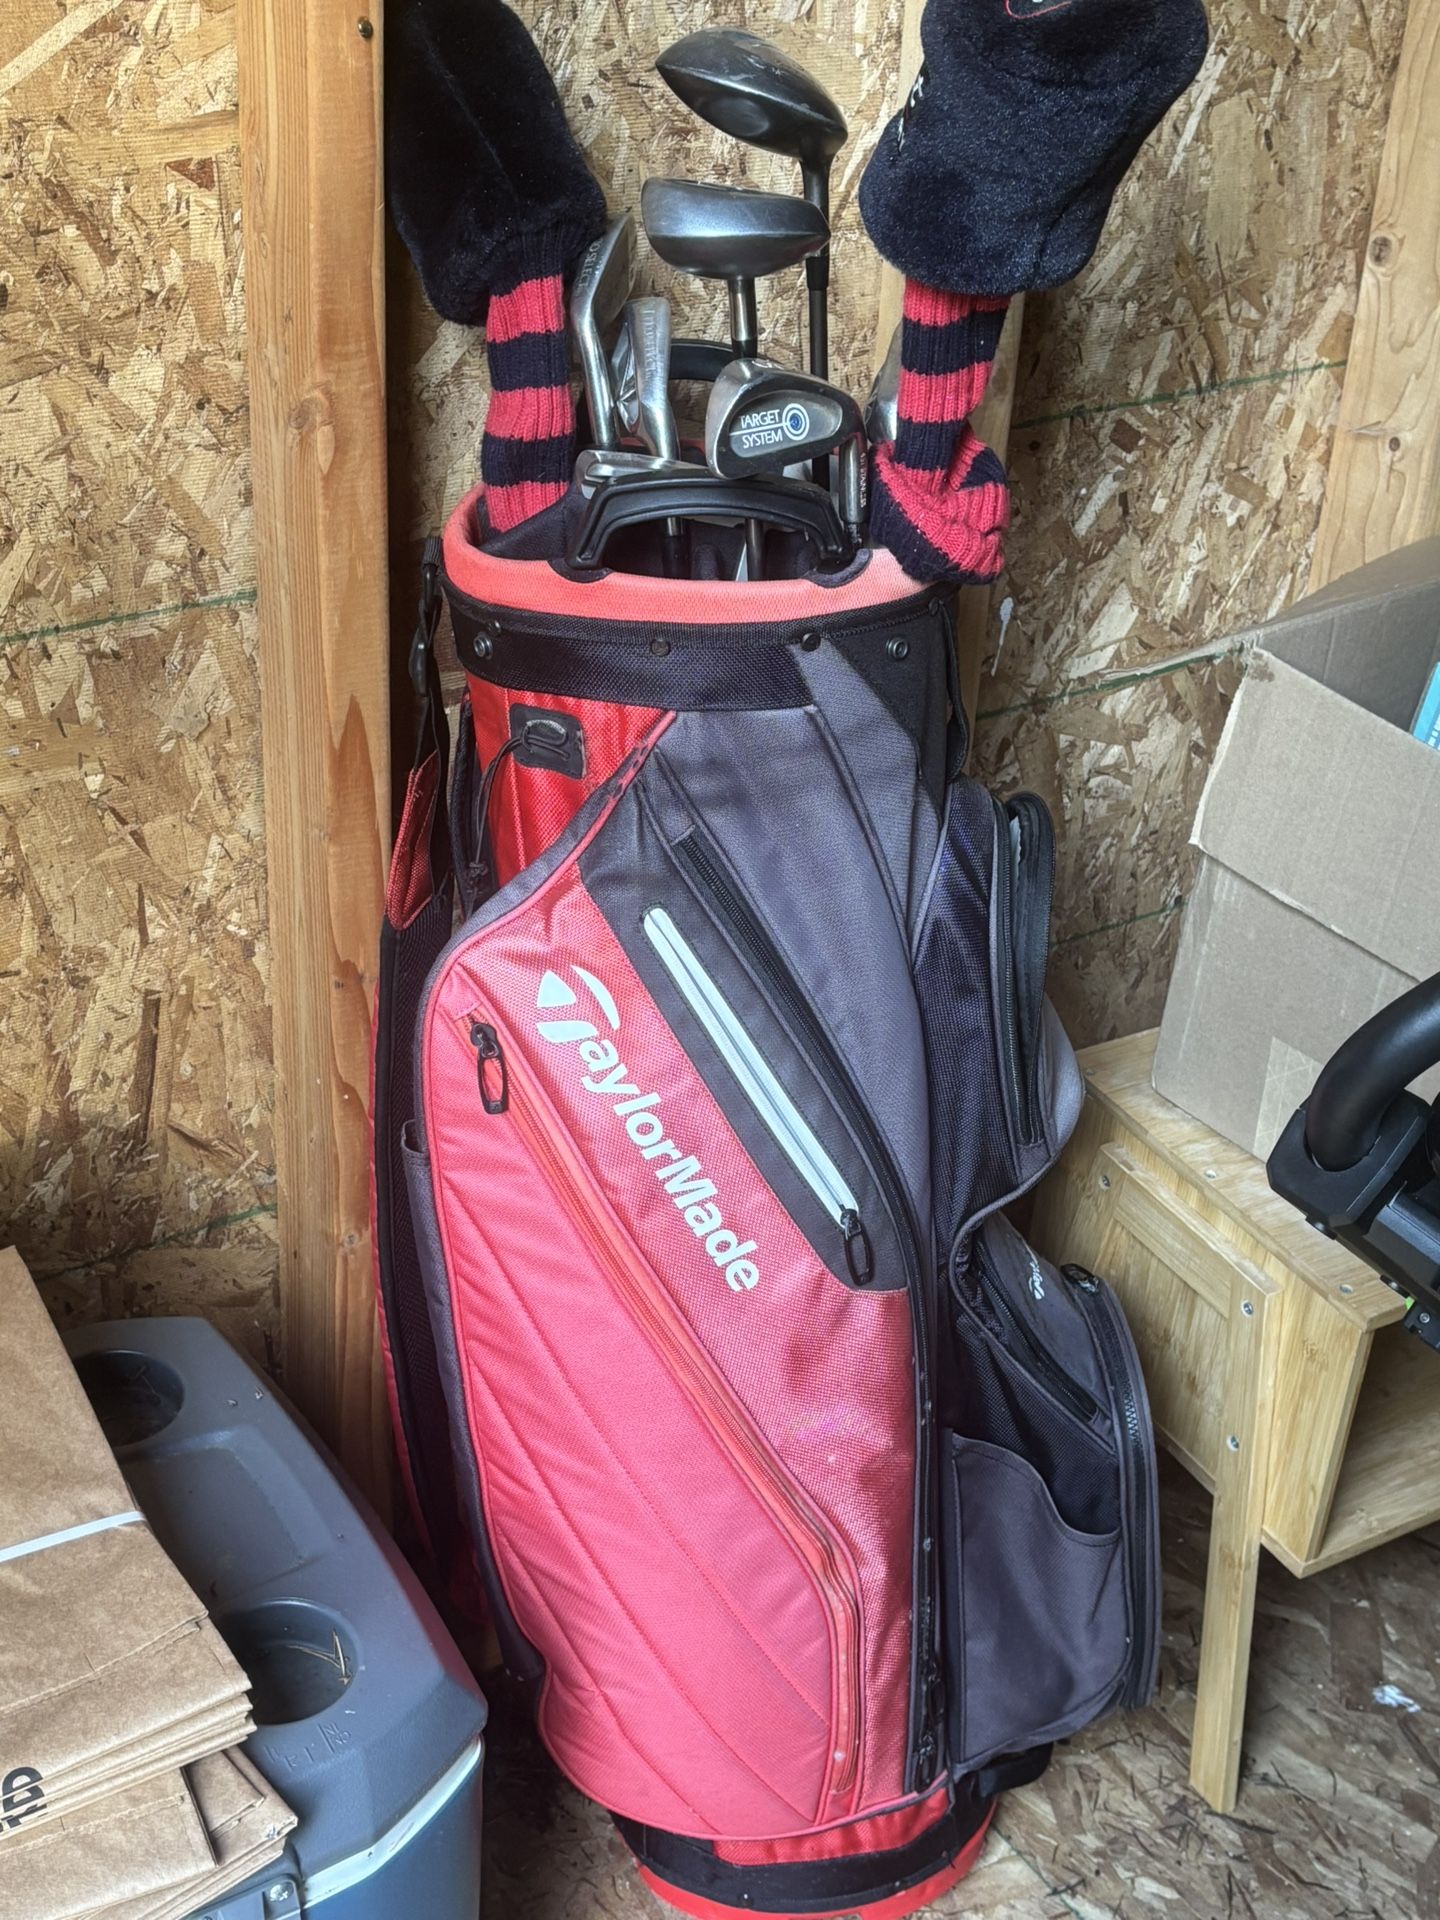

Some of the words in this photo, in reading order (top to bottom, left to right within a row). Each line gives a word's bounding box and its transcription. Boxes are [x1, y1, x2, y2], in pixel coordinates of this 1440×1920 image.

[740, 409, 780, 429] TARGET
[742, 428, 782, 449] SYSTEM
[536, 965, 760, 1292] TaylorMade
